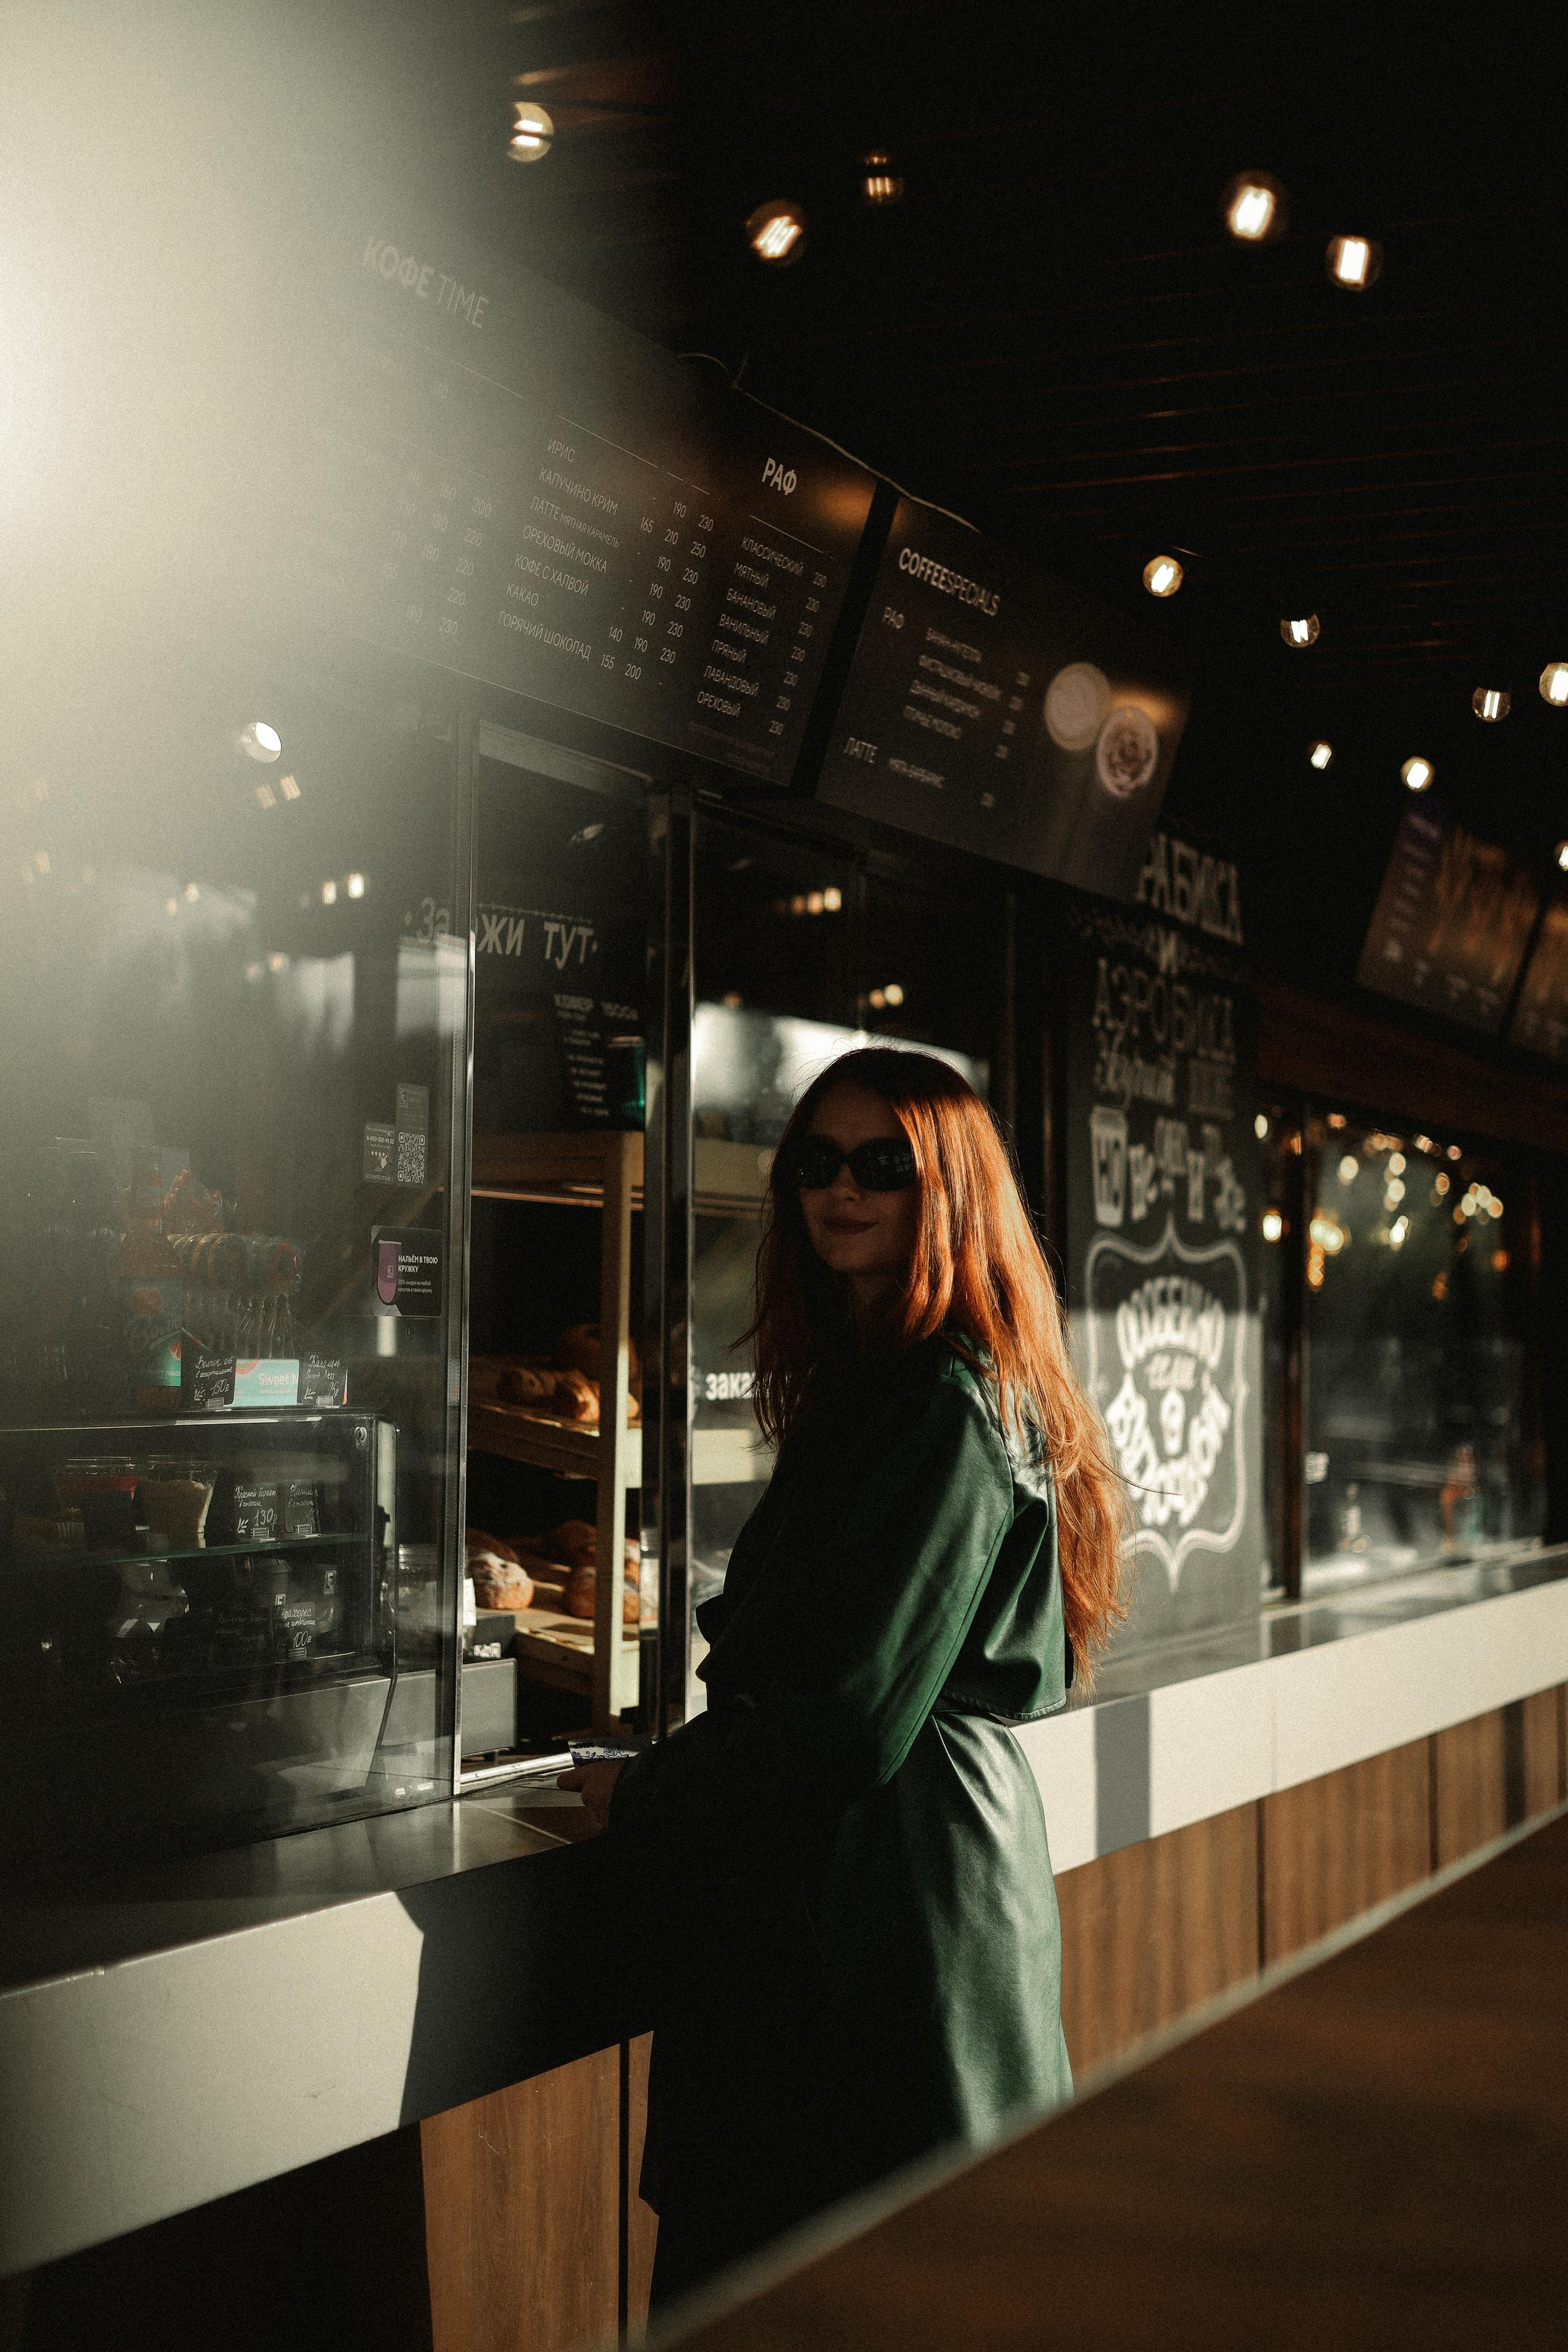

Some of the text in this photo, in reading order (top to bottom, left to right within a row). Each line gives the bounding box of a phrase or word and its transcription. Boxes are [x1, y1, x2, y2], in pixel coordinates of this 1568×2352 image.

[362, 235, 489, 328] КОФЕ TIME
[547, 437, 714, 532] ИРИС 190 230
[761, 457, 797, 496] РАФ
[472, 497, 492, 517] 200
[539, 466, 706, 559] КАПУЧИНО КРИМ 165 210 250
[464, 528, 483, 547] 220
[529, 496, 699, 585] ЛАТТЕ МЯТНАЯ КАРАМЕЛЬ 190 230
[456, 558, 475, 576] 220
[522, 525, 692, 612] ОРЕХОВЫЙ МОККА 190 230
[741, 537, 804, 576] КЛАССИЧЕСКИЙ
[733, 562, 769, 589] МЯТНЫЙ
[899, 547, 1001, 616] COFFEESPECIALS
[447, 587, 466, 606] 220
[514, 553, 684, 639] КОФЕ С ХАЛВОЙ 190 230
[726, 587, 777, 621] БАНАНОВЫЙ
[439, 616, 458, 635] 230
[505, 582, 676, 665] КАКАО 140 190 230
[718, 613, 769, 646] ВАНИЛЬНЫЙ
[498, 611, 642, 680] ГОРЯЧИЙ ШОКОЛАД 155 200
[711, 639, 747, 664] ПРЯНЫЙ
[703, 665, 760, 697] ЛАВАНДОВЫЙ
[696, 691, 742, 718] ОРЕХОВЫЙ
[398, 1254, 419, 1263] НАЛЬЁМ
[423, 1256, 438, 1264] ТВОЮ
[258, 1373, 288, 1385] Sweet
